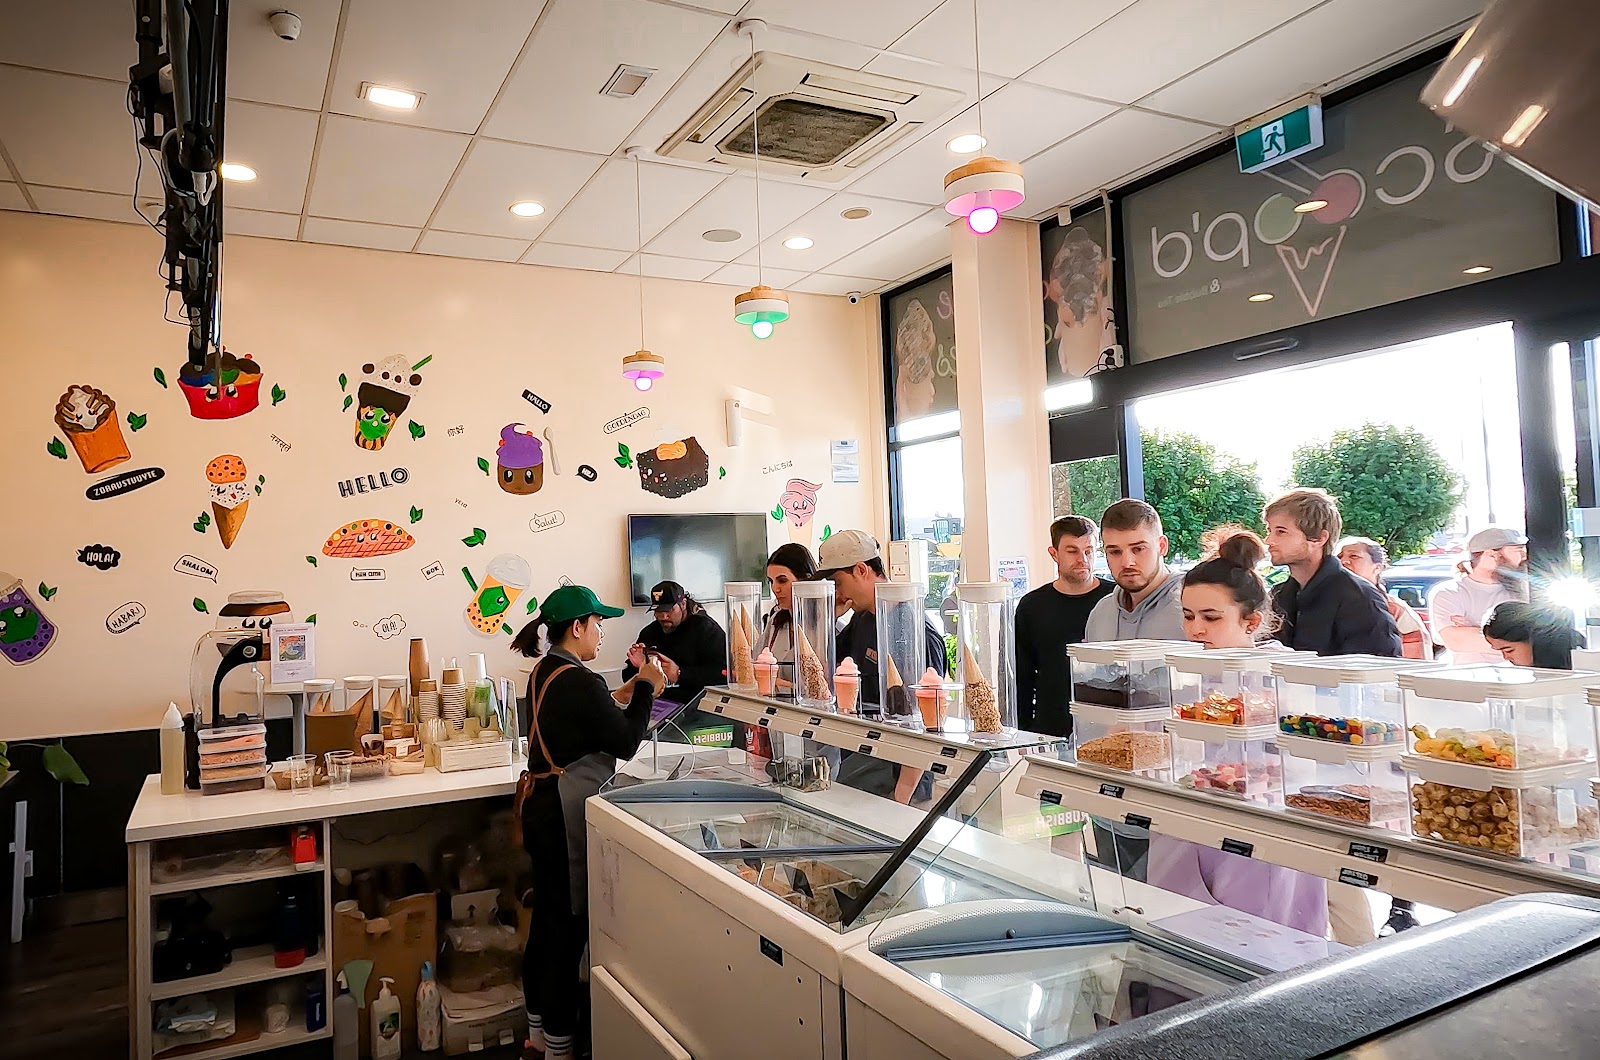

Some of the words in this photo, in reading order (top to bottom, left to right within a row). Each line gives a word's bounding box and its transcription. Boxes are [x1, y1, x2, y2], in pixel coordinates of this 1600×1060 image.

[526, 393, 549, 411] HALLO
[606, 409, 647, 432] GOEDENDAG
[447, 424, 465, 438] 你好
[762, 460, 793, 475] こんにちは
[337, 466, 411, 499] HELLO
[534, 513, 558, 530] Salut!
[86, 551, 115, 564] HOLA!
[181, 558, 213, 577] SHALOM
[426, 566, 440, 576] BOK
[111, 606, 141, 630] HABARI
